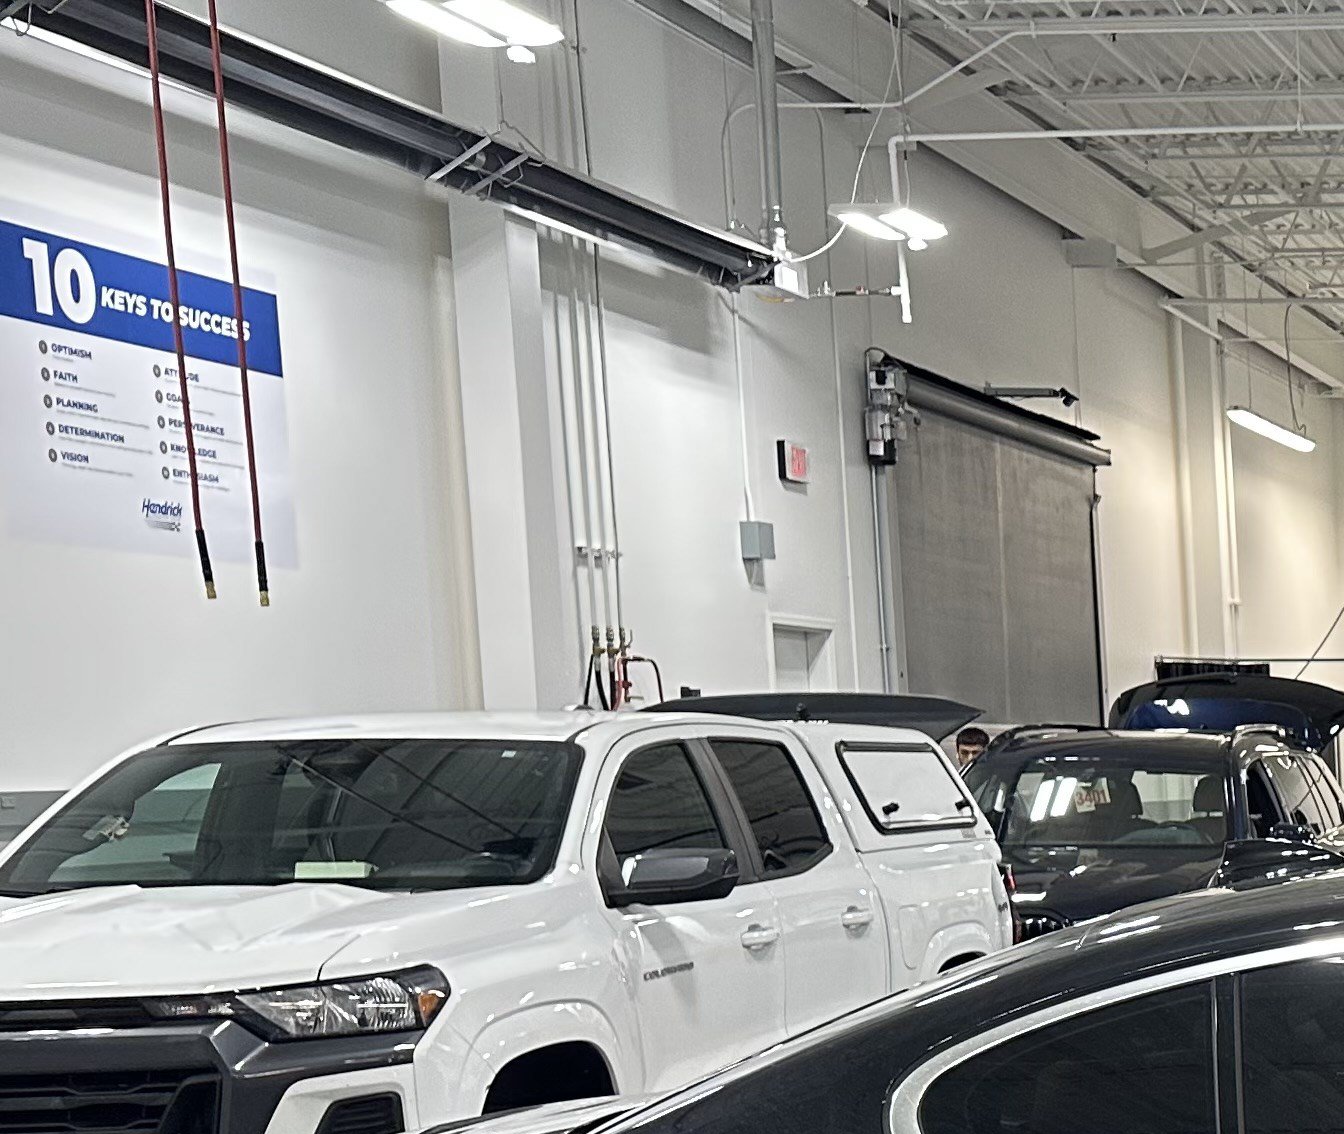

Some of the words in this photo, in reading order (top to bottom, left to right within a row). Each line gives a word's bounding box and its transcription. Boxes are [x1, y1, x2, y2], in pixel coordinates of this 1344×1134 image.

[22, 238, 96, 324] 10
[101, 286, 147, 317] KEYS
[150, 298, 175, 323] TO
[179, 305, 250, 342] SUCCESS
[51, 343, 92, 360] OPTIMISM
[53, 370, 78, 383] FAITH
[164, 368, 200, 383] ATTDE
[56, 397, 98, 413] PLANNING
[58, 424, 125, 443] DETERMINATION
[168, 418, 225, 436] PERVERANCE
[60, 451, 89, 463] VISION
[170, 443, 217, 459] KNOEDGE
[142, 498, 183, 517] Hendrick
